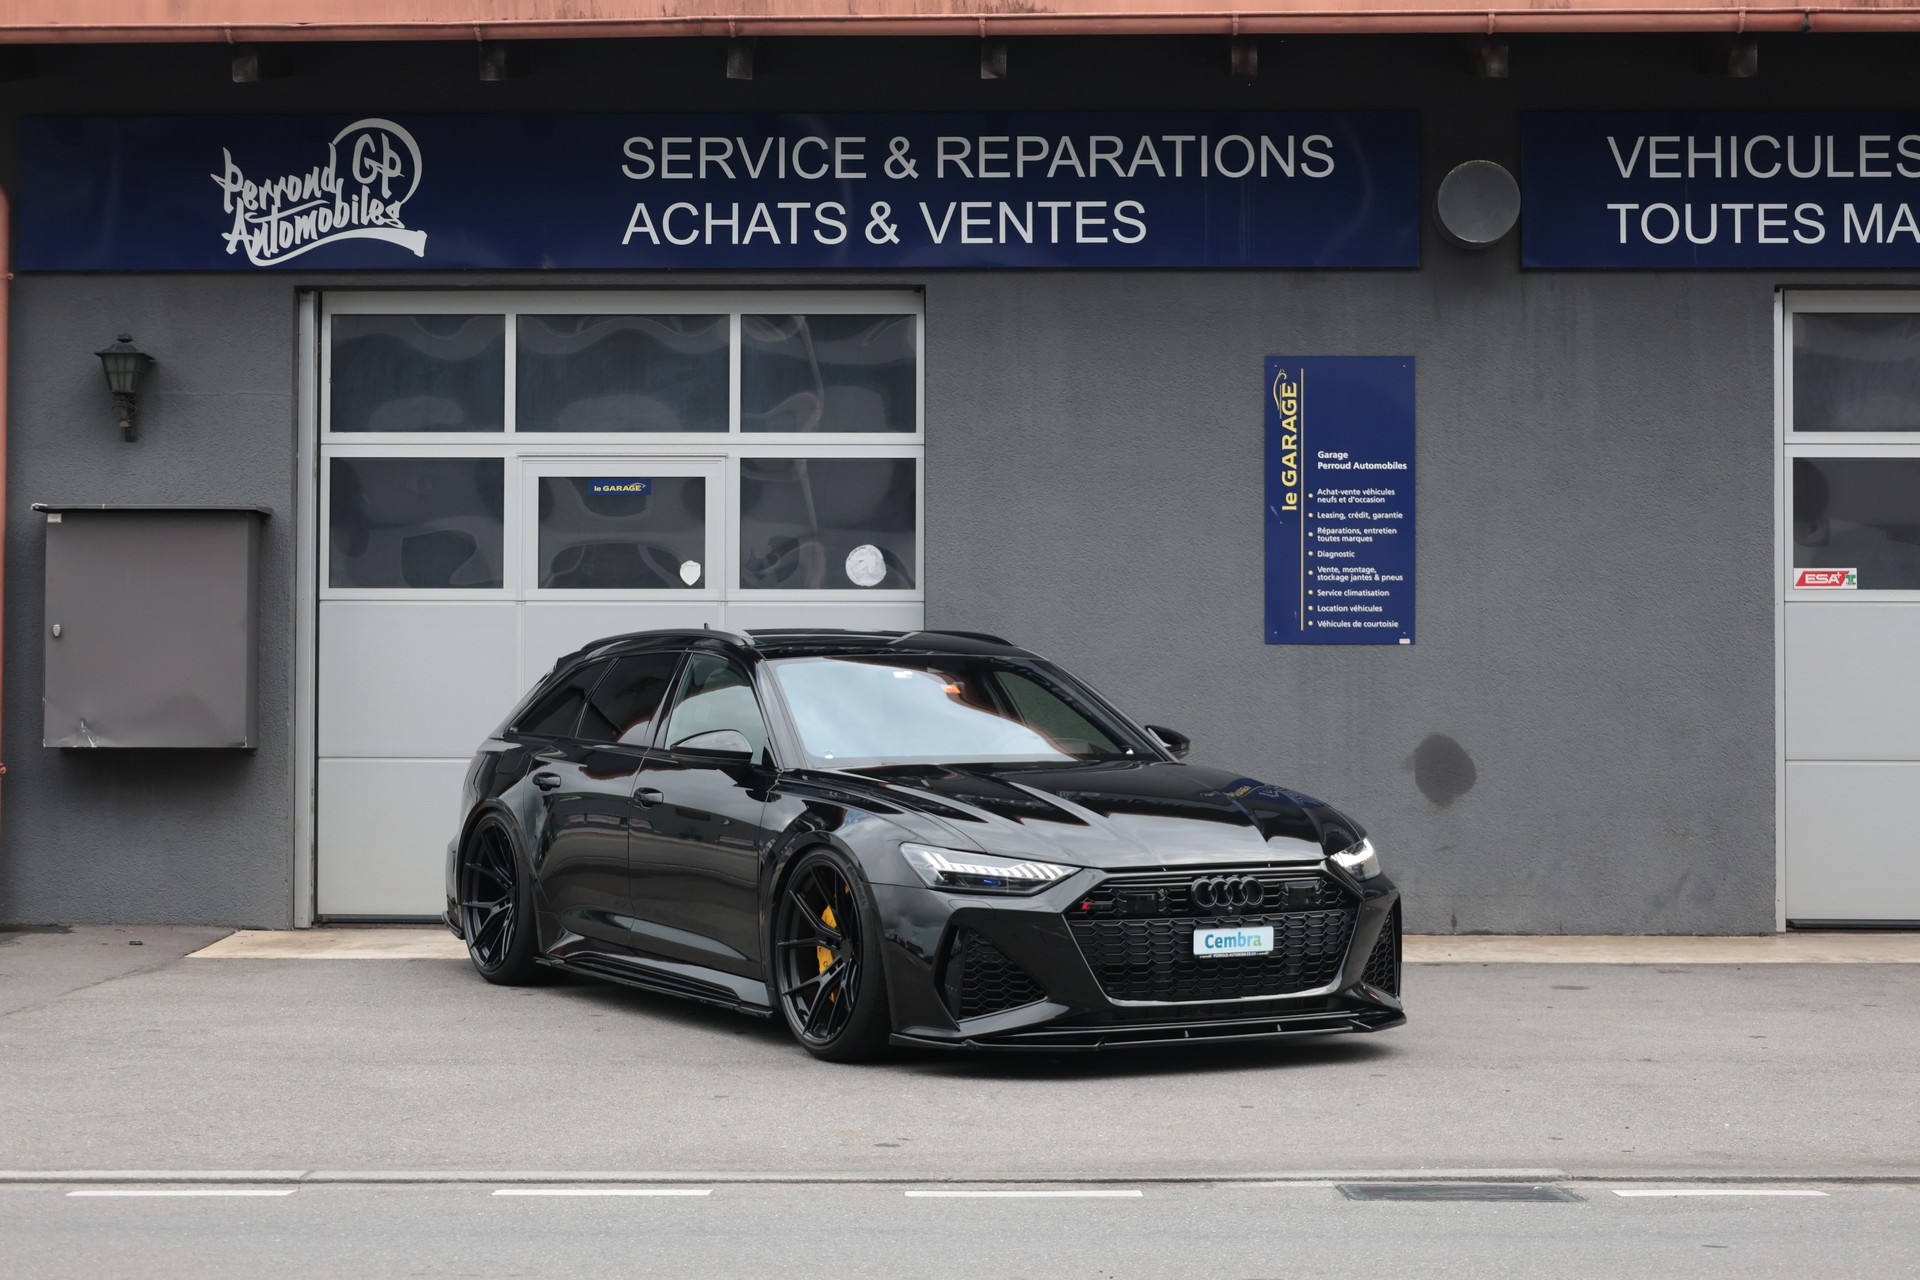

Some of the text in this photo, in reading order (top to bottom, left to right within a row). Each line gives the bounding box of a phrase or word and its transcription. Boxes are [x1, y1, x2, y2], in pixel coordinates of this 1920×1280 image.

[621, 134, 1336, 180] SERVICE & REPARATIONS
[1606, 134, 1920, 179] VEHICULES
[621, 200, 1147, 246] ACHATS & VENTES
[1606, 202, 1920, 245] TOUTES MA
[1281, 382, 1298, 511] le GARAGE
[1317, 450, 1349, 461] Garage
[1317, 461, 1408, 470] Perroud Automobiles
[1317, 488, 1396, 496] Achat-vente véhicules
[1317, 511, 1404, 521] Leasing, crédit, garantie
[1317, 526, 1398, 536] Réparations, entretien
[1317, 535, 1373, 544] toutes marques
[1317, 550, 1356, 560] Diagnostic
[1317, 566, 1377, 575] Vente, montage,
[1317, 573, 1404, 582] stockage jantes & pneus
[1317, 588, 1390, 597] Service climatisation
[1317, 604, 1383, 612] Location véhicules
[1317, 619, 1399, 628] Véhicules de courtoisie
[1204, 931, 1262, 949] Cembra
